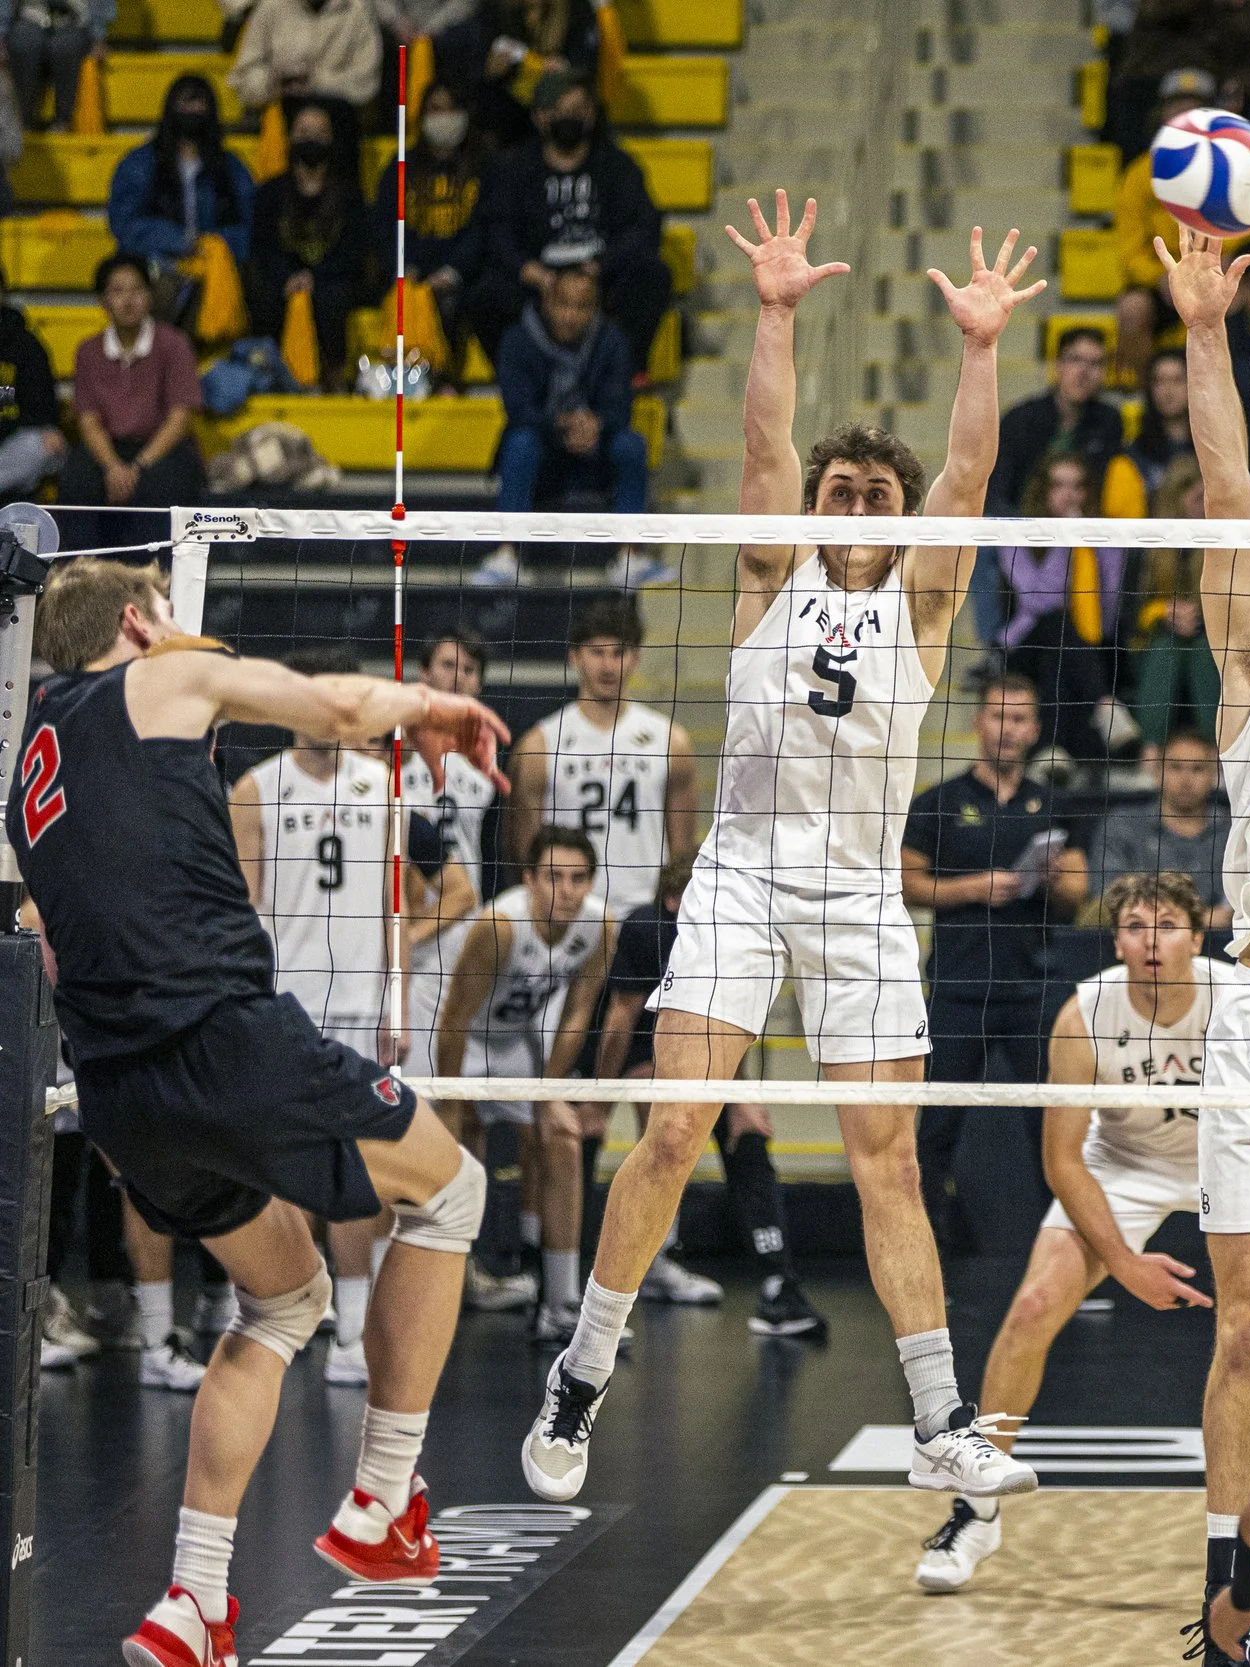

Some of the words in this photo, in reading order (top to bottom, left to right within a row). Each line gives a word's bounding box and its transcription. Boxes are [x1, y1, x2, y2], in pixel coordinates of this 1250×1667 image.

[204, 514, 241, 523] Senoh
[807, 643, 858, 718] 5
[21, 723, 67, 849] 2
[581, 778, 637, 834] 24
[283, 809, 372, 833] BEACH
[317, 834, 344, 892] 9
[1122, 1053, 1203, 1083] BEAC
